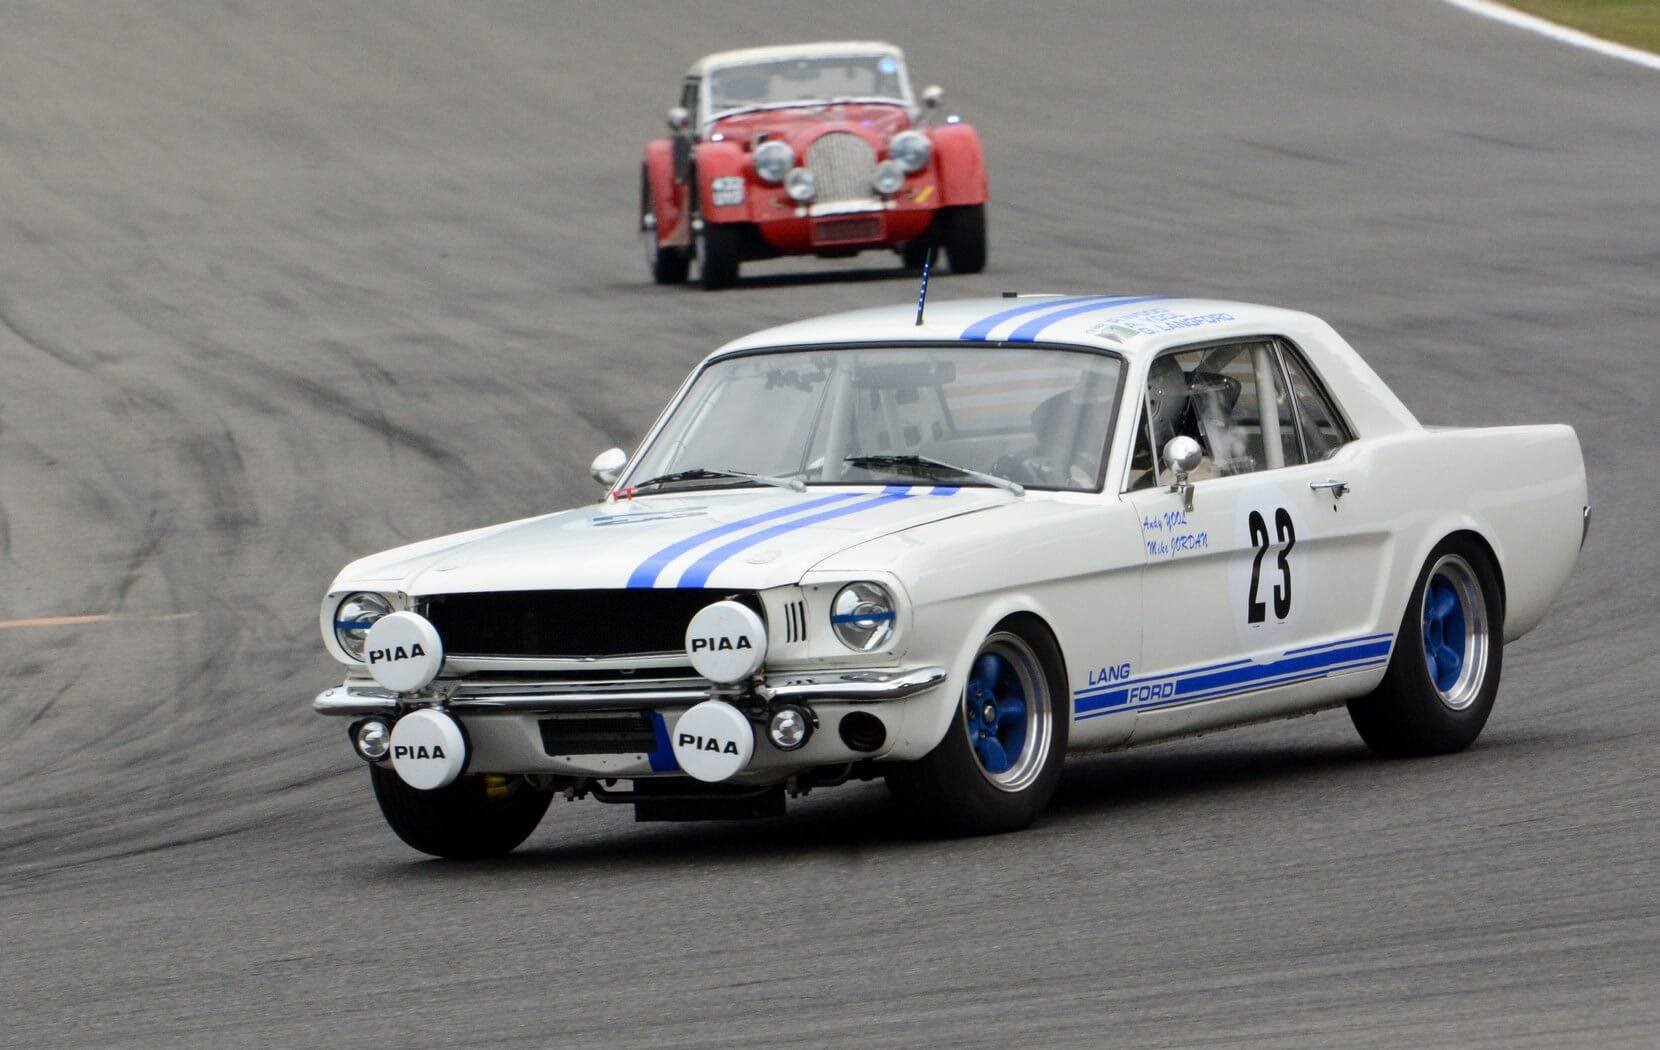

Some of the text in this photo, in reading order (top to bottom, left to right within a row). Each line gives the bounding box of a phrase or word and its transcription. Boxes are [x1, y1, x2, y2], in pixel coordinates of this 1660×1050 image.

[1155, 313, 1236, 331] LANGFORD
[1143, 510, 1188, 532] Andy YOOL
[1147, 533, 1208, 556] Mike JORDAN
[1248, 507, 1296, 624] 23
[369, 643, 426, 664] PIAA
[691, 635, 752, 652] PIAA
[1088, 663, 1131, 686] LANG
[1128, 682, 1174, 703] FORD
[394, 745, 446, 760] PIAA
[678, 733, 738, 755] PIAA
